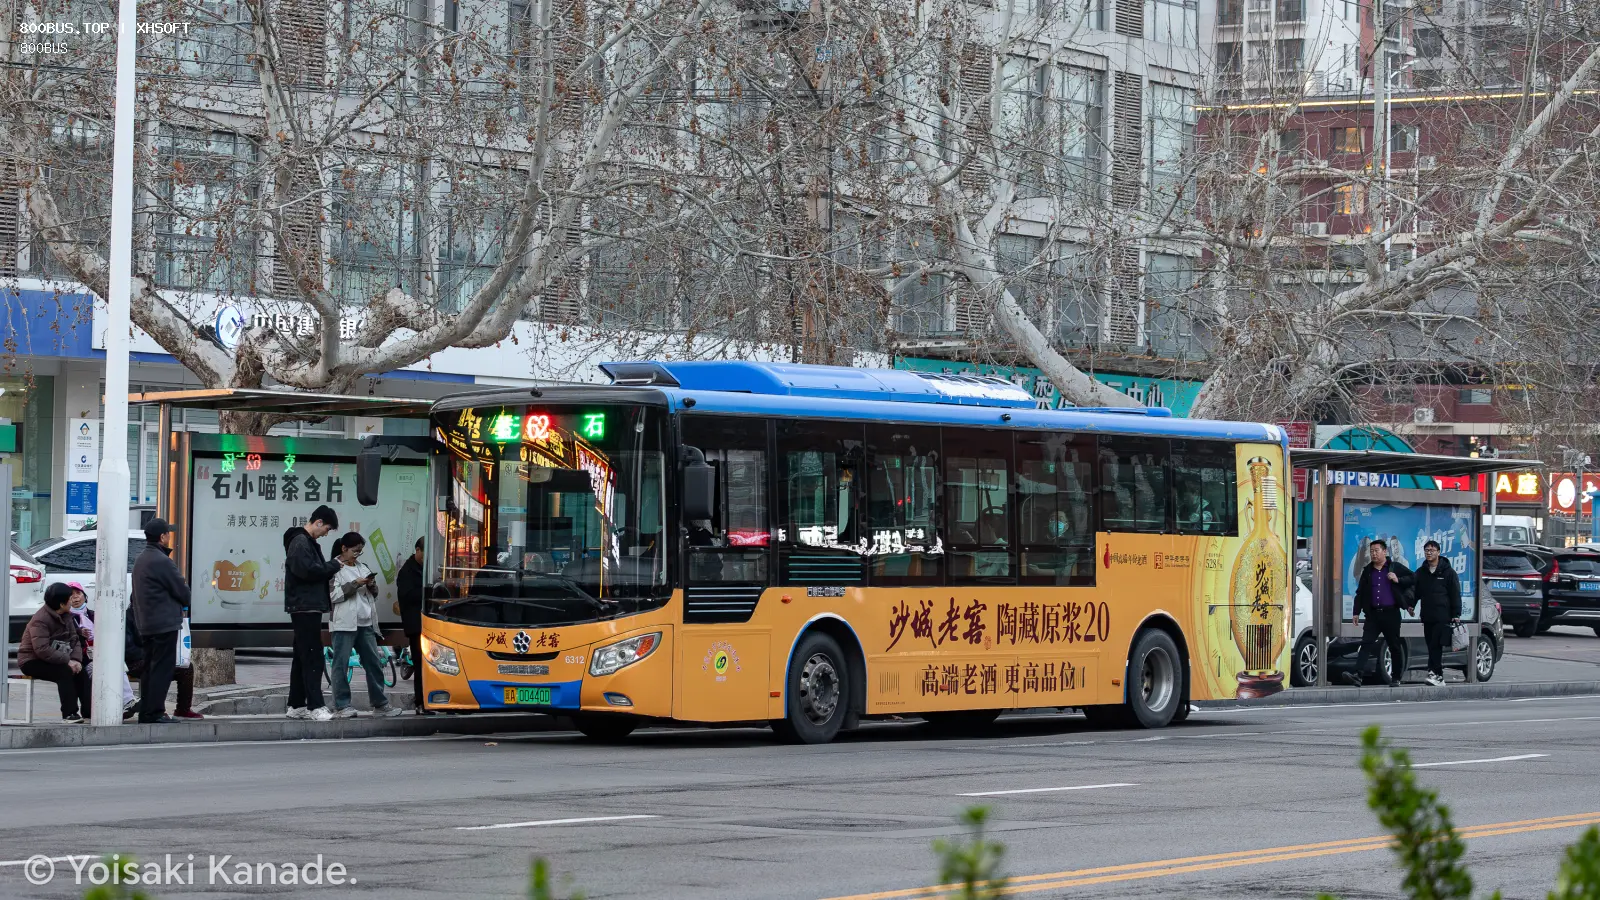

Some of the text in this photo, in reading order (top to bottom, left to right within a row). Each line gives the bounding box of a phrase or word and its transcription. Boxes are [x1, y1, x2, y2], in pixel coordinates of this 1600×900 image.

[526, 415, 549, 438] 62
[584, 414, 604, 436] 石
[212, 473, 343, 502] 石小喵茶含片
[1349, 471, 1356, 485] P
[227, 515, 279, 528] 清爽又清润
[231, 577, 242, 588] 27
[997, 601, 1110, 645] 陶藏原浆20
[565, 656, 584, 664] 6312
[921, 662, 1075, 696] 高端老酒 更高品位
